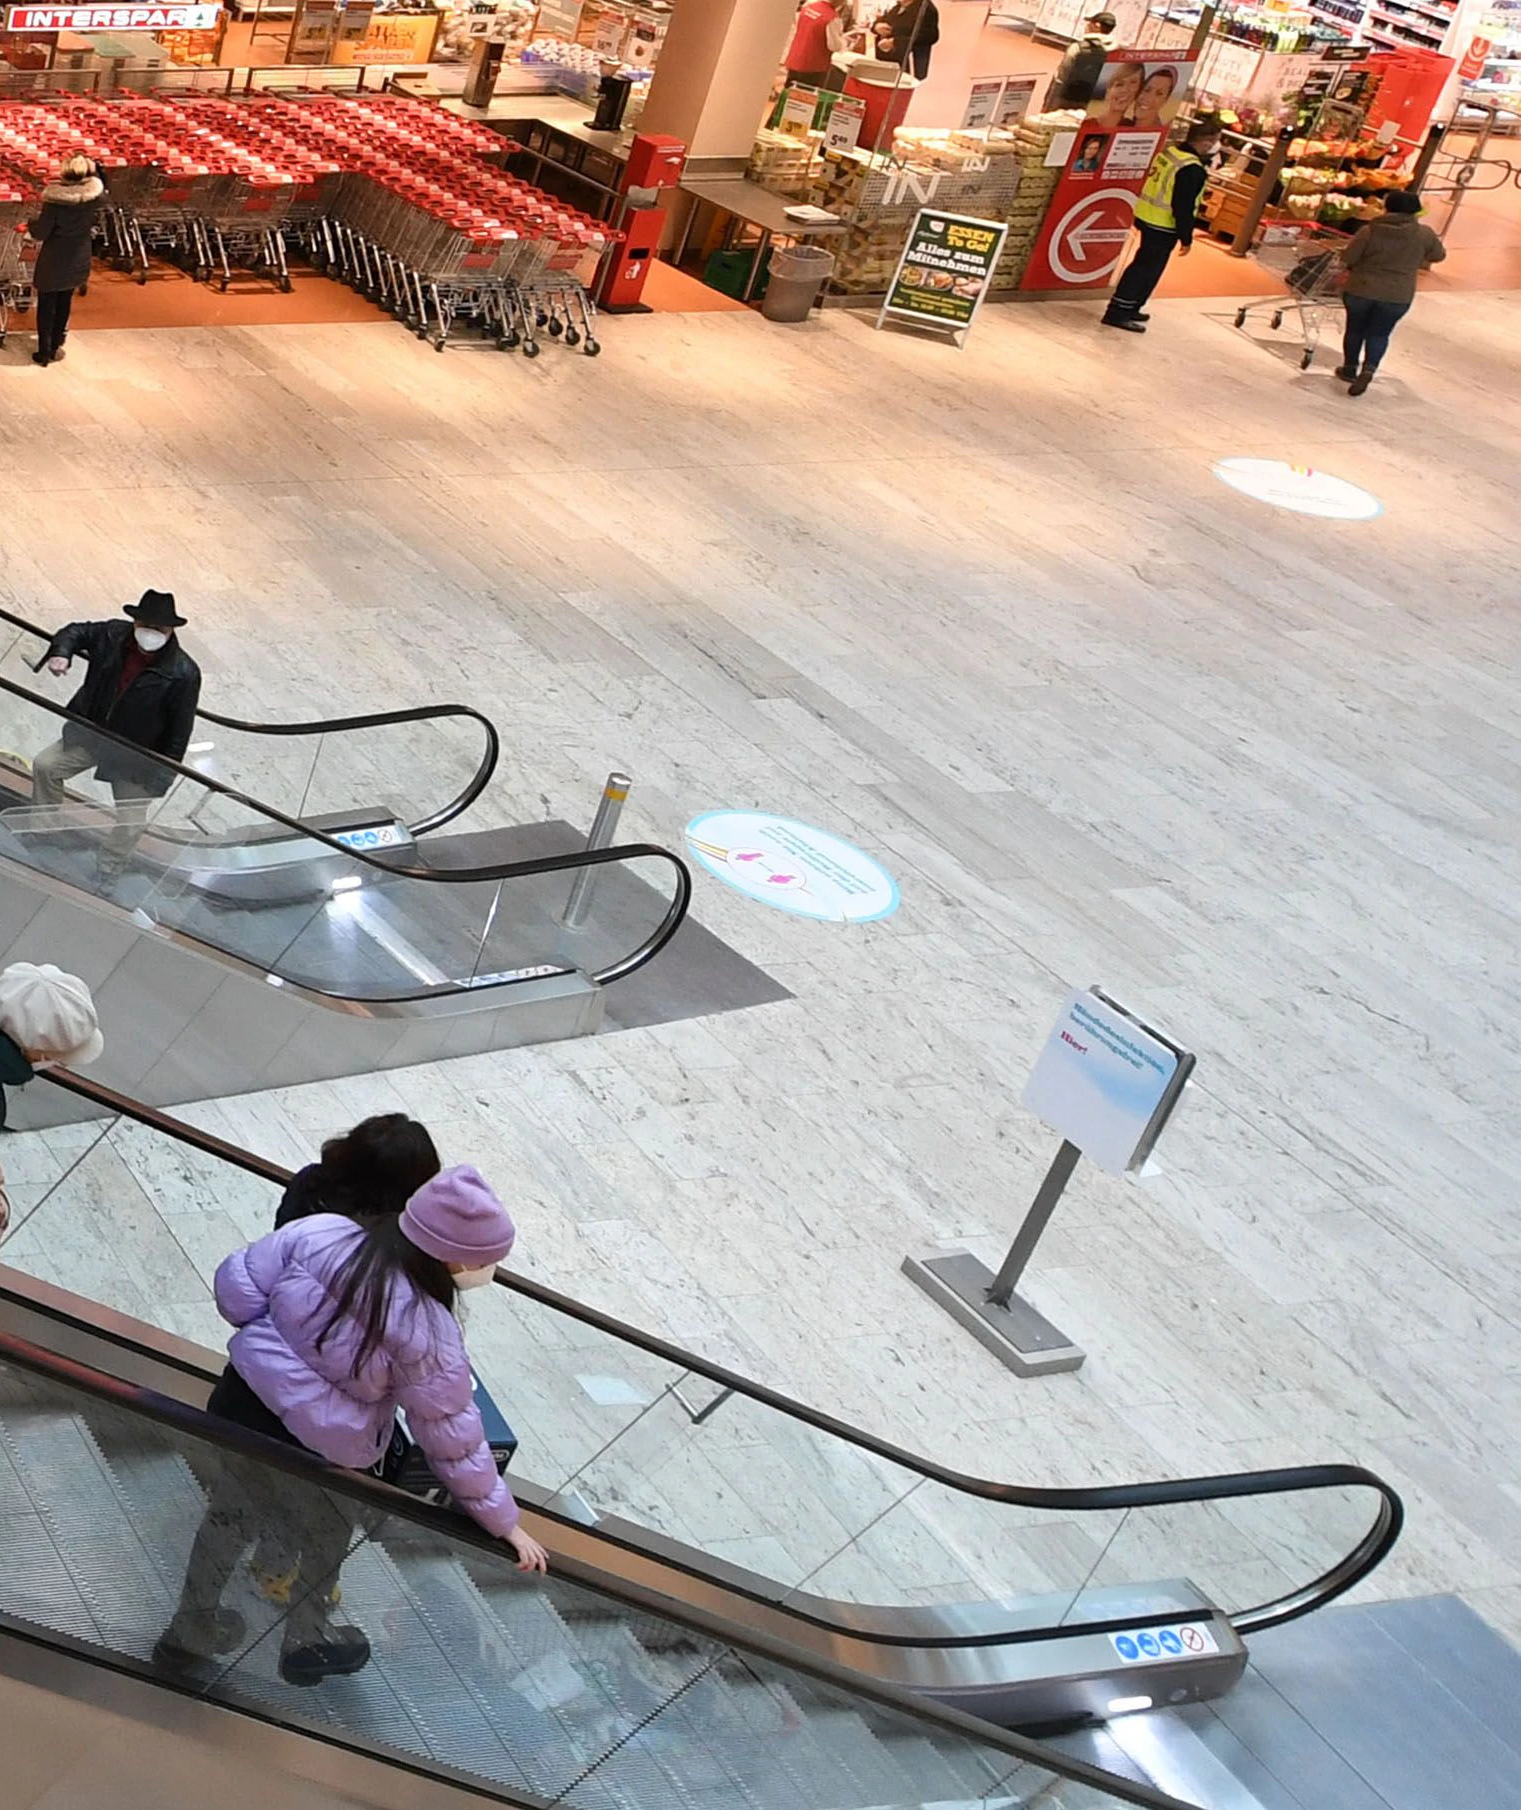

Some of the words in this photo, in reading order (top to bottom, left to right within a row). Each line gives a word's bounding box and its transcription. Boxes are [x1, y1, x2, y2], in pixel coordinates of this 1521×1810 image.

[25, 9, 186, 27] INTERSPAR
[881, 173, 941, 205] IN
[947, 235, 965, 247] To
[966, 239, 990, 253] Go!
[948, 225, 996, 243] ESSEN
[907, 251, 987, 276] Mitnehmen
[916, 242, 951, 257] Alles
[953, 251, 985, 265] zum
